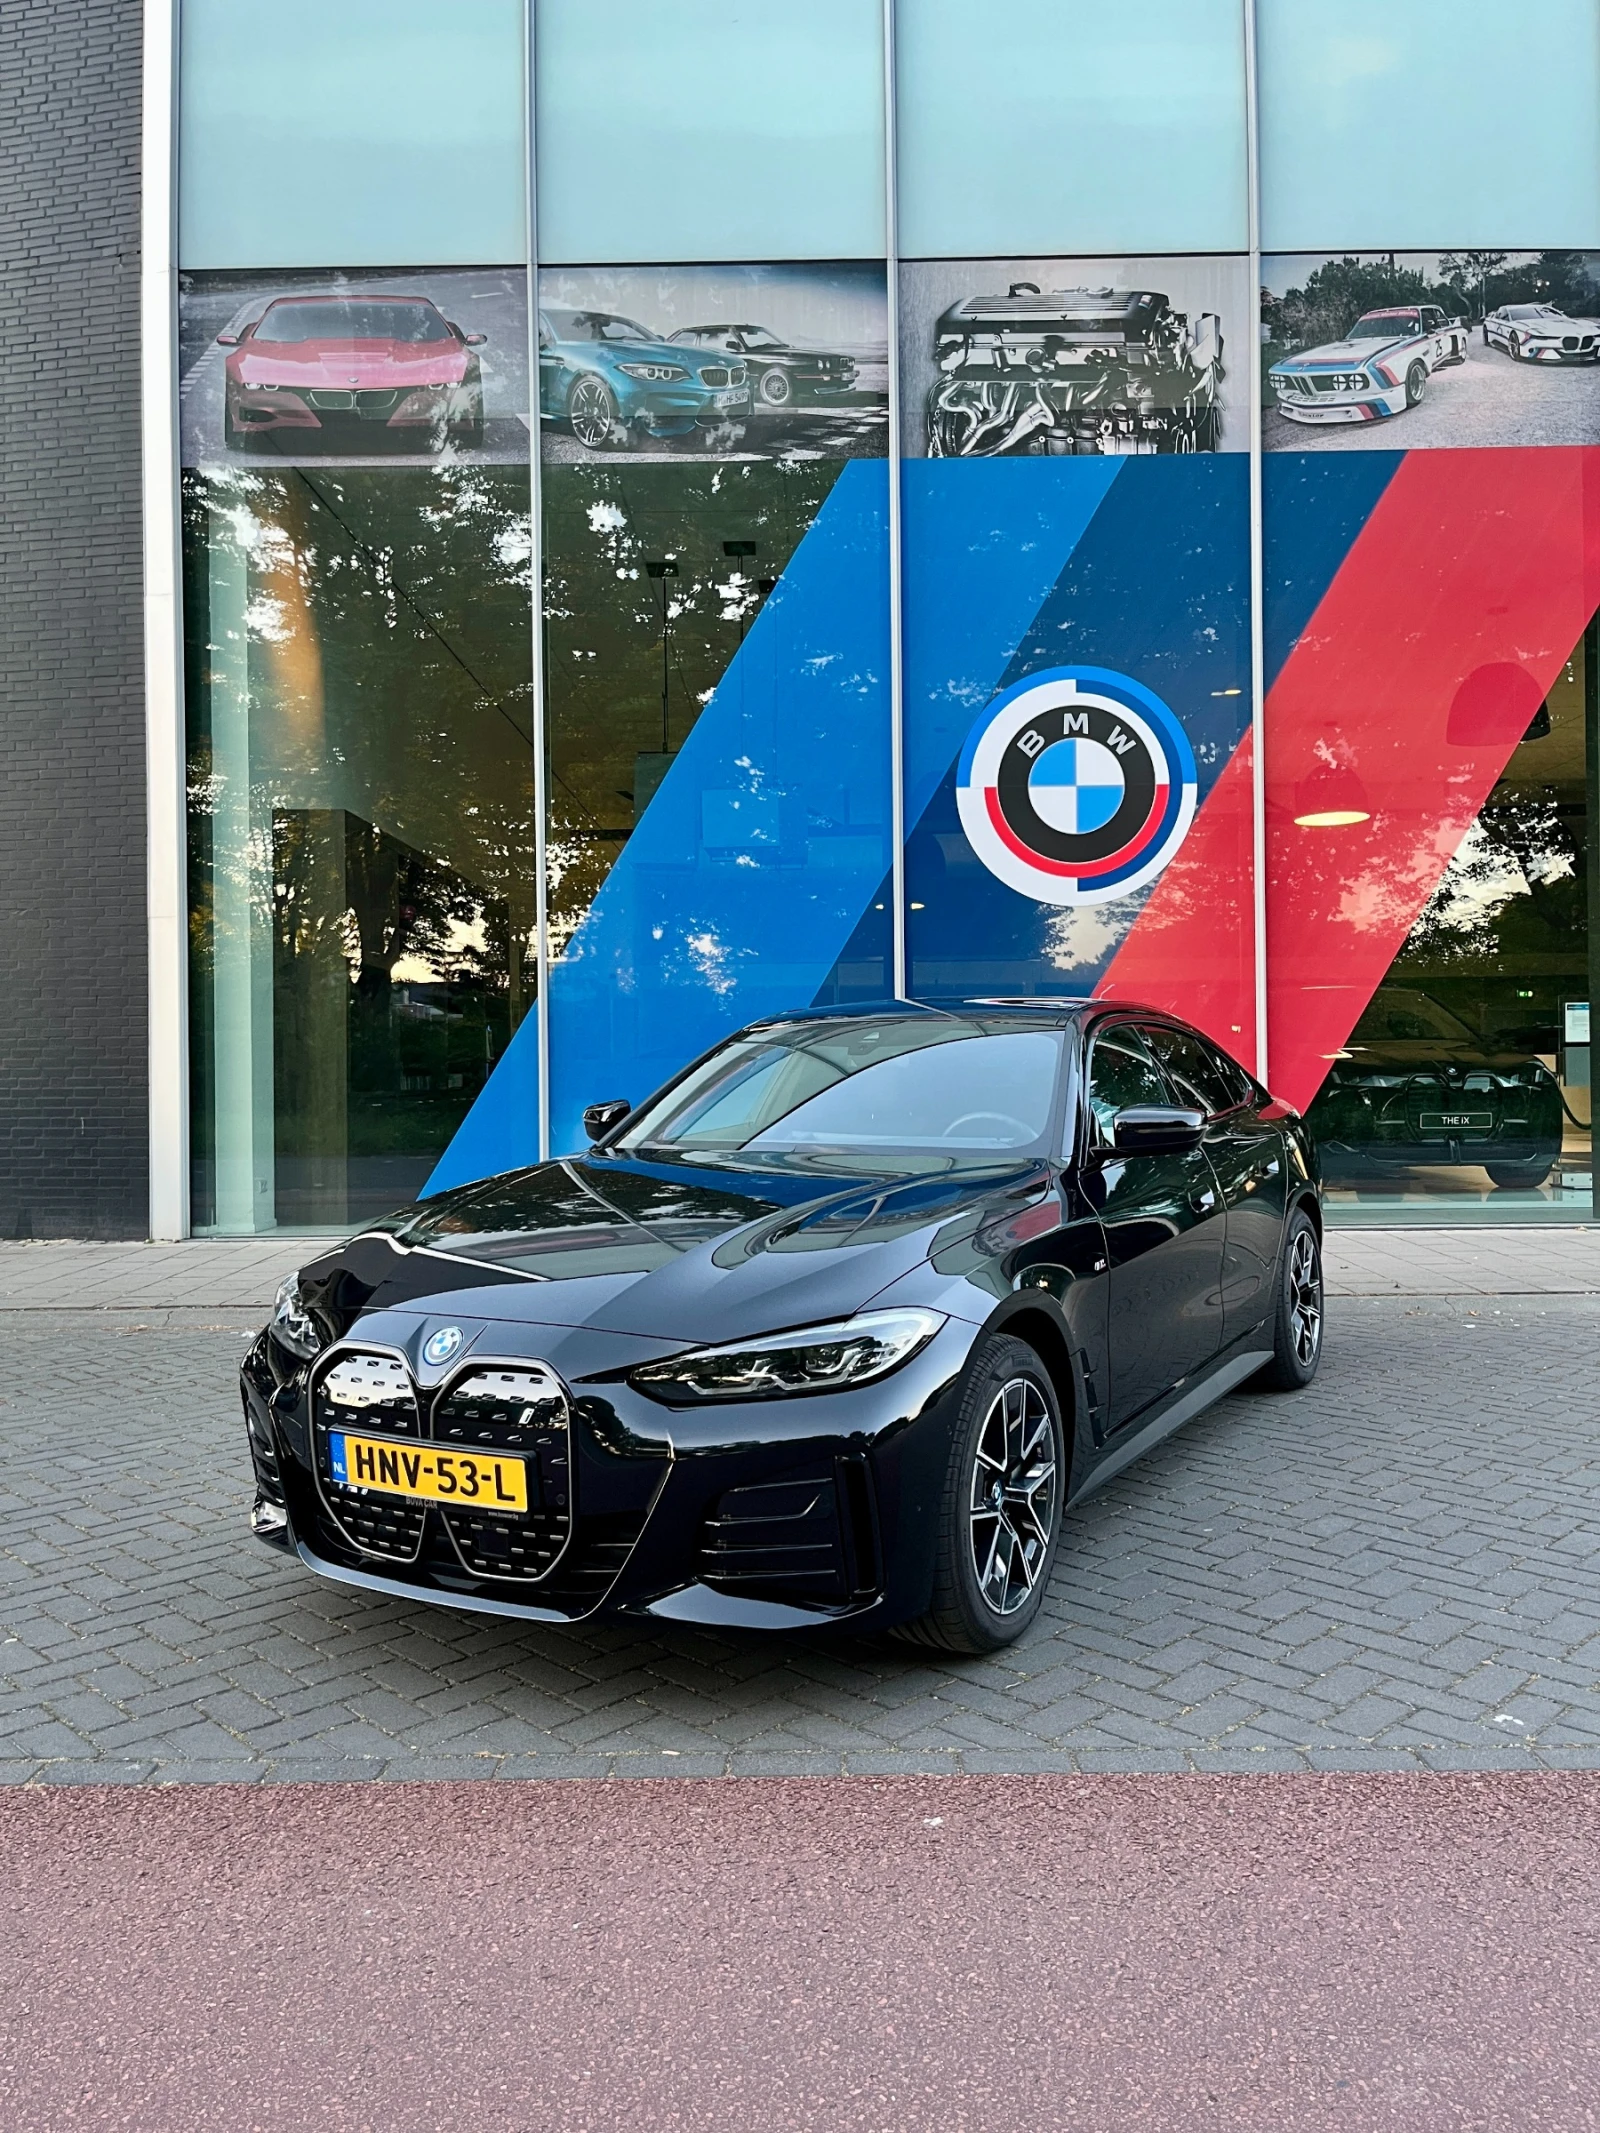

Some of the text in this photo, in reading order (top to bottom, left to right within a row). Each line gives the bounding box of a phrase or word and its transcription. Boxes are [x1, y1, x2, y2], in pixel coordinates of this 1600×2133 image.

[1016, 712, 1137, 759] BMW
[1441, 1116, 1460, 1125] THE
[333, 1461, 346, 1474] NL
[355, 1443, 516, 1502] HNV-53-L
